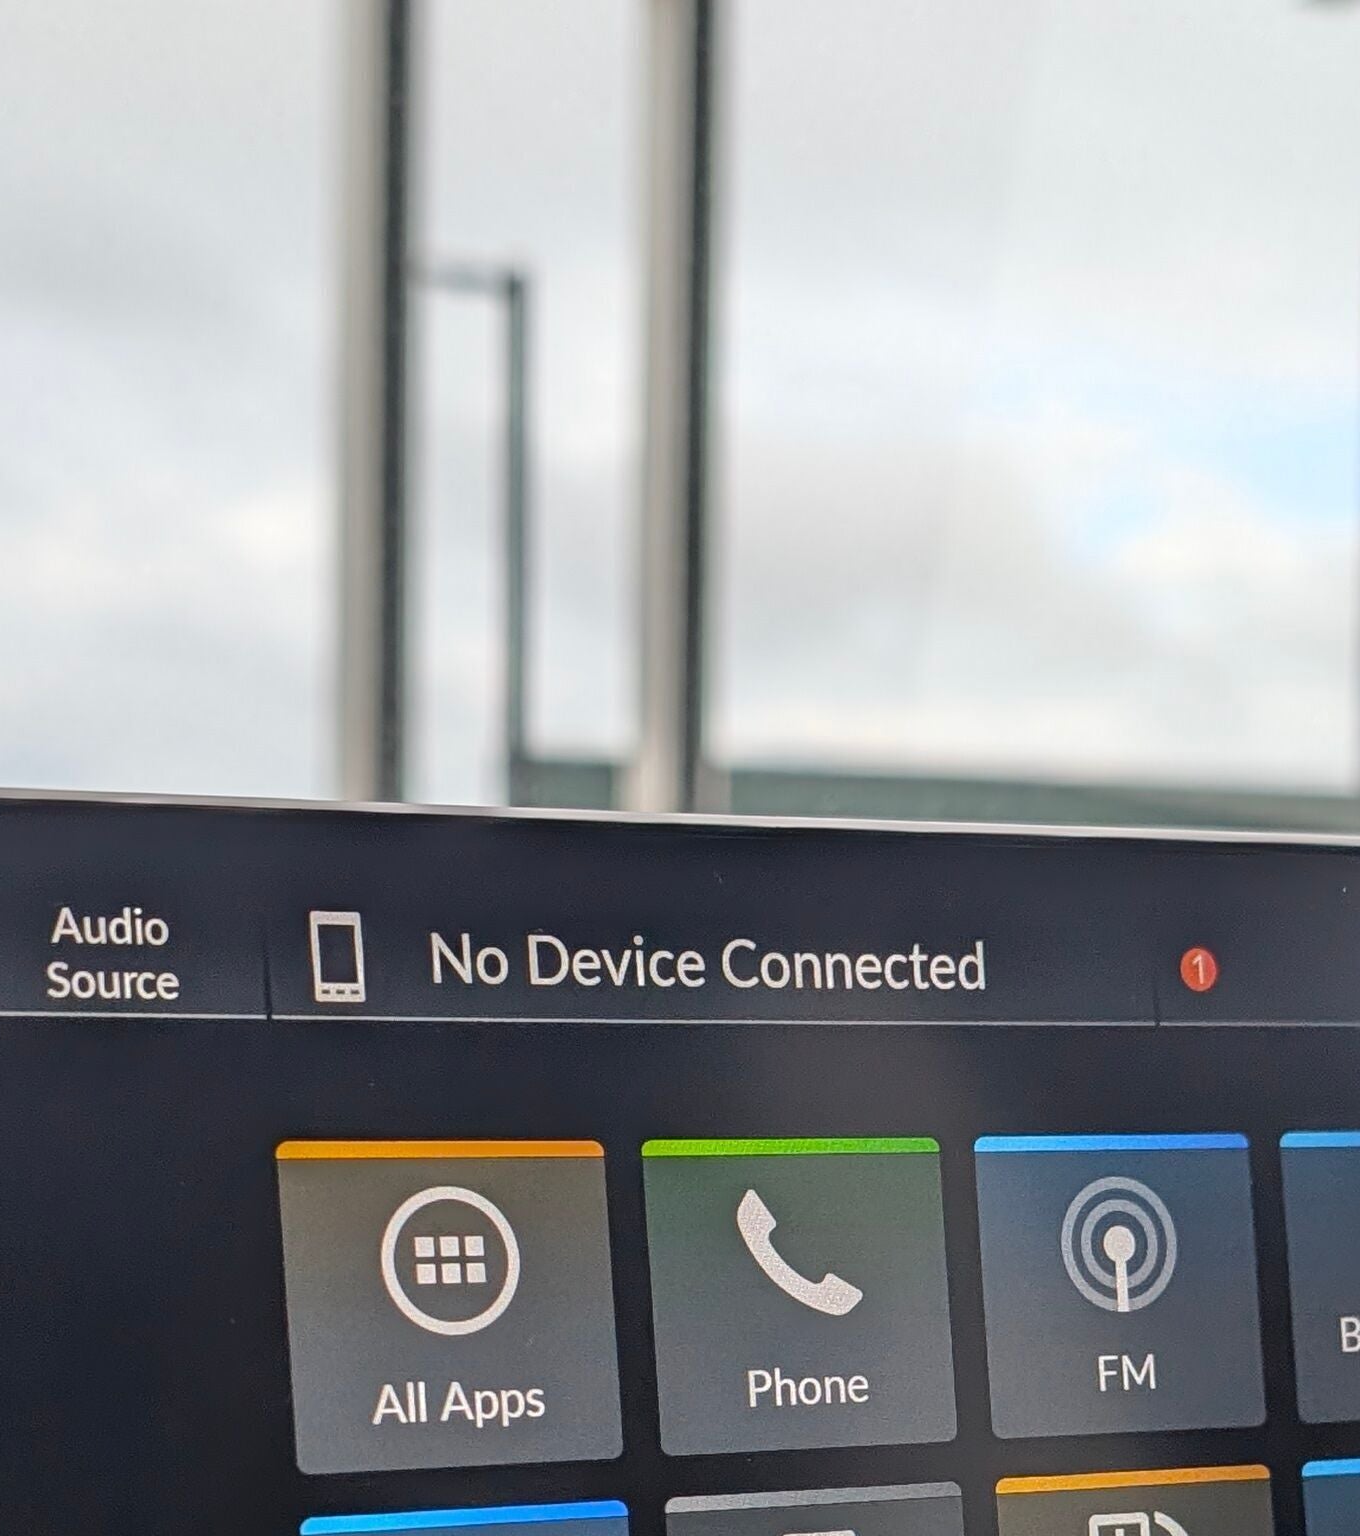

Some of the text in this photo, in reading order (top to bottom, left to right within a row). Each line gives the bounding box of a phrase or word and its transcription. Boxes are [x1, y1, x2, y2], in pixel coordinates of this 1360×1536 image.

[51, 906, 169, 946] Audio
[47, 961, 180, 1000] Source
[430, 932, 986, 990] No Device Connected
[748, 1367, 869, 1408] Phone
[1098, 1353, 1156, 1392] FM
[372, 1381, 546, 1429] All Apps
